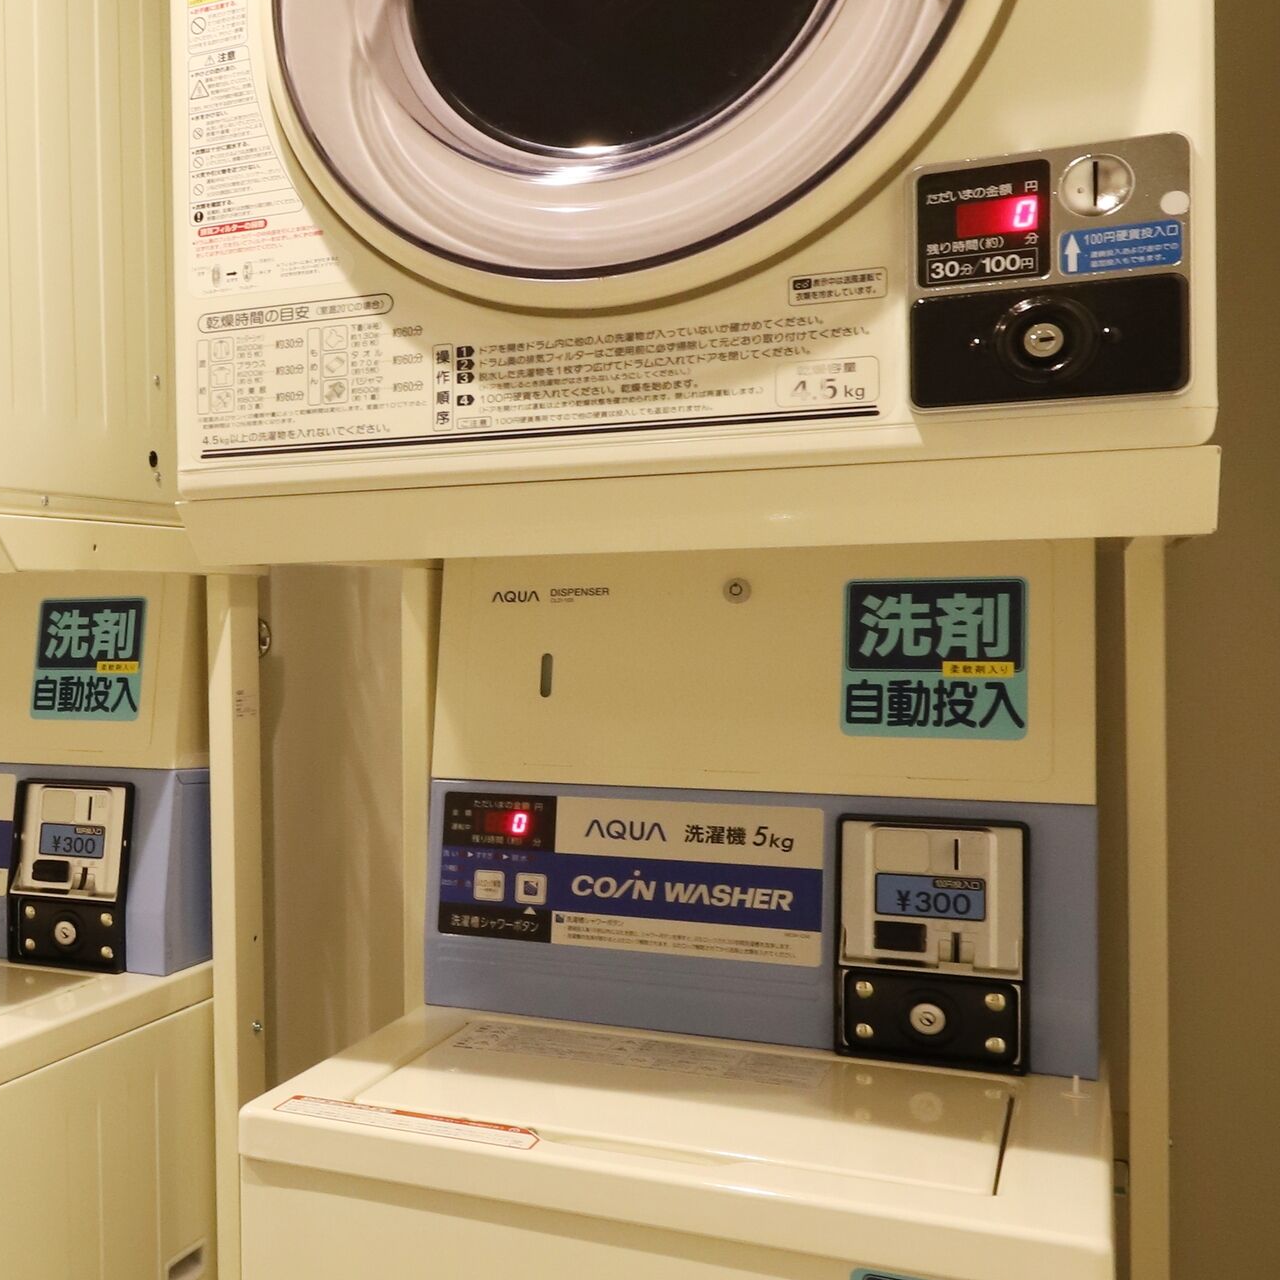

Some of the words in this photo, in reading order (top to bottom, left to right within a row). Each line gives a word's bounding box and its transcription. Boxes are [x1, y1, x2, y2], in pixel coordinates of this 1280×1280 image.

[926, 183, 1013, 205] ただいまの金額
[1024, 180, 1039, 193] 円
[1013, 200, 1037, 228] 0
[1024, 232, 1040, 245] 分
[1084, 224, 1180, 246] 100円硬貨投入口
[206, 307, 310, 330] 乾燥時間の目安
[435, 349, 451, 427] 操作順序
[844, 384, 866, 400] kg
[491, 590, 540, 604] AQUA
[550, 587, 610, 598] DISPENSER
[45, 608, 136, 660] 洗剤
[859, 592, 1010, 658] 洗剤
[949, 664, 1009, 676] 柔軟剤入り
[33, 675, 139, 714] 自動投入
[846, 678, 1025, 729] 自動投入
[511, 812, 528, 834] 0
[585, 818, 667, 842] AQUA
[684, 824, 747, 847] 洗濯機
[752, 826, 795, 853] 5kg
[52, 835, 96, 854] ¥300
[664, 880, 795, 912] WASHER
[896, 889, 972, 916] ¥300
